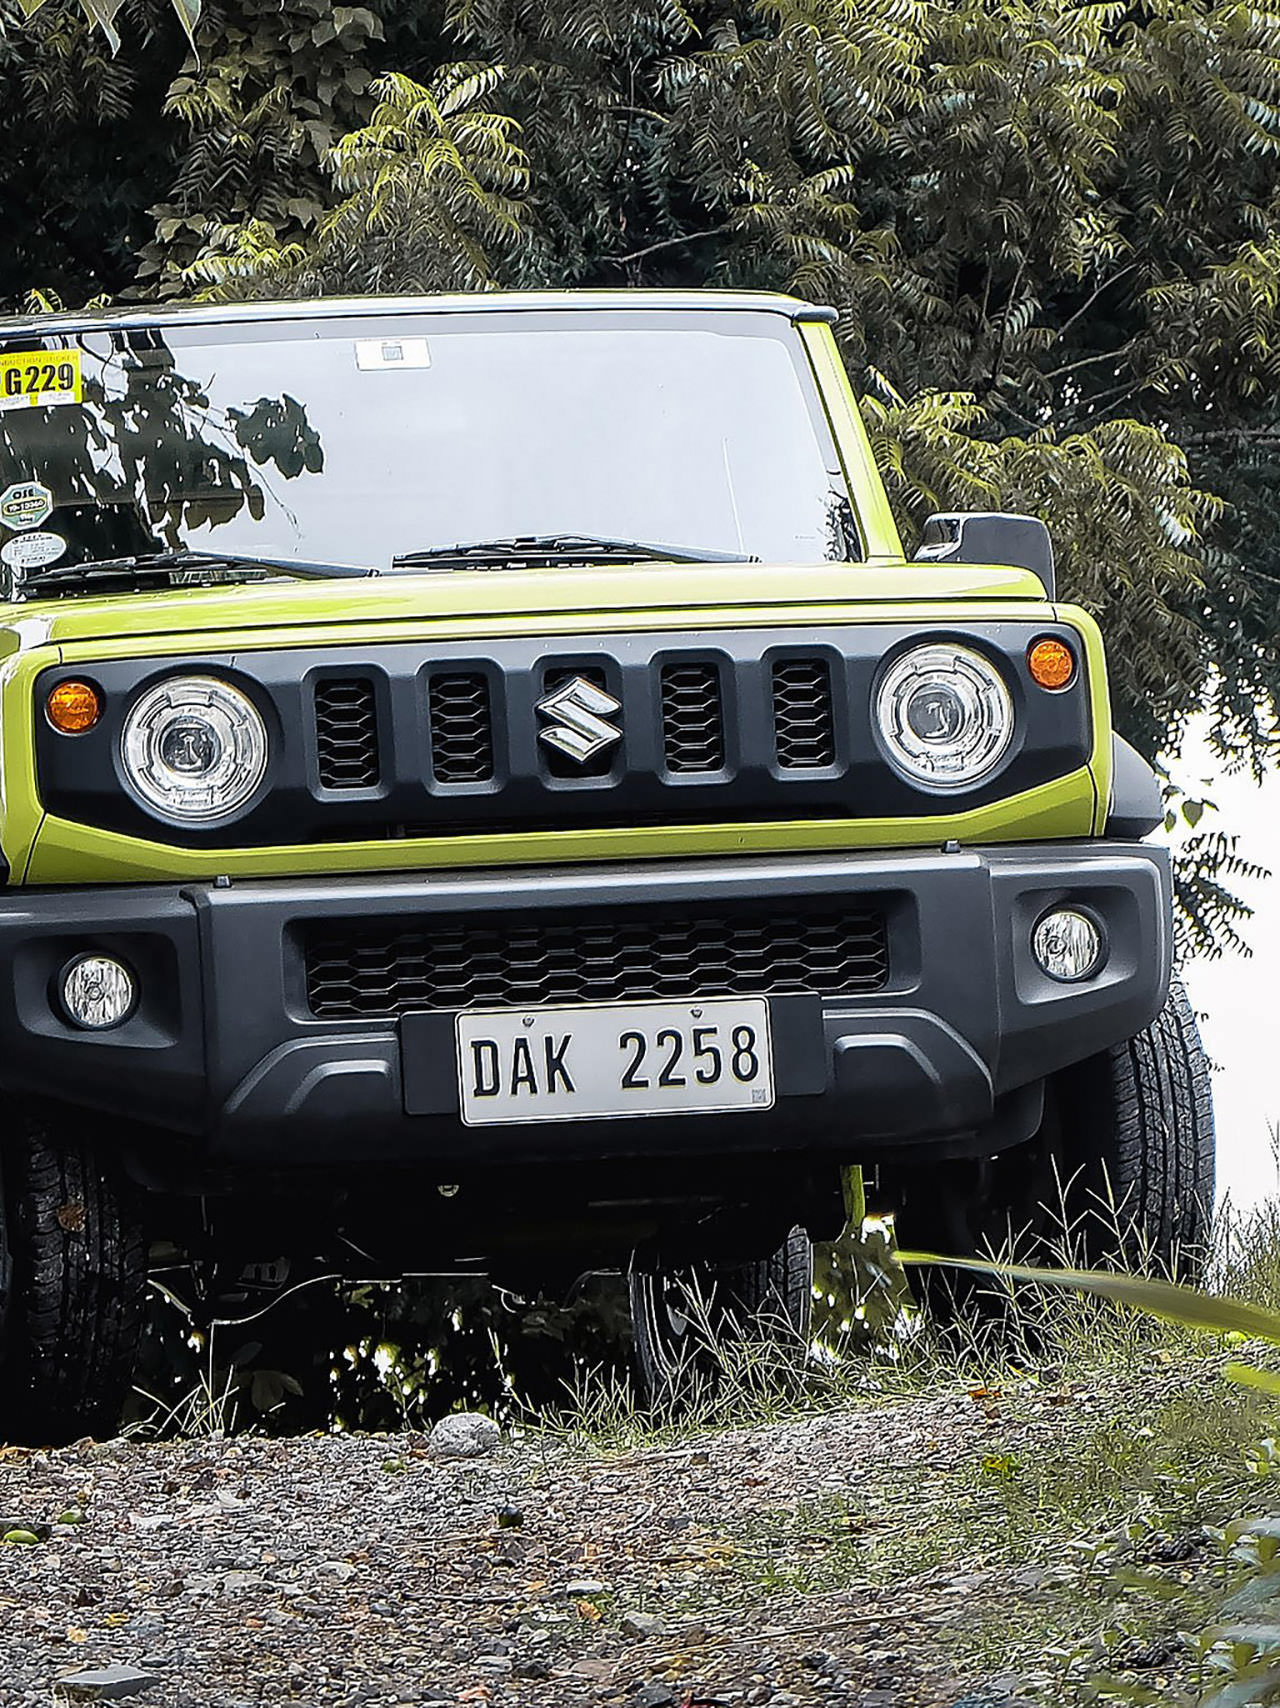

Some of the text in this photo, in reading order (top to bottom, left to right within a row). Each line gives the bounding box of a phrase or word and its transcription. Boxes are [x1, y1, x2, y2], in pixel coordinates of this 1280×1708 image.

[5, 363, 74, 395] G229
[470, 1025, 760, 1098] DAK 2258
